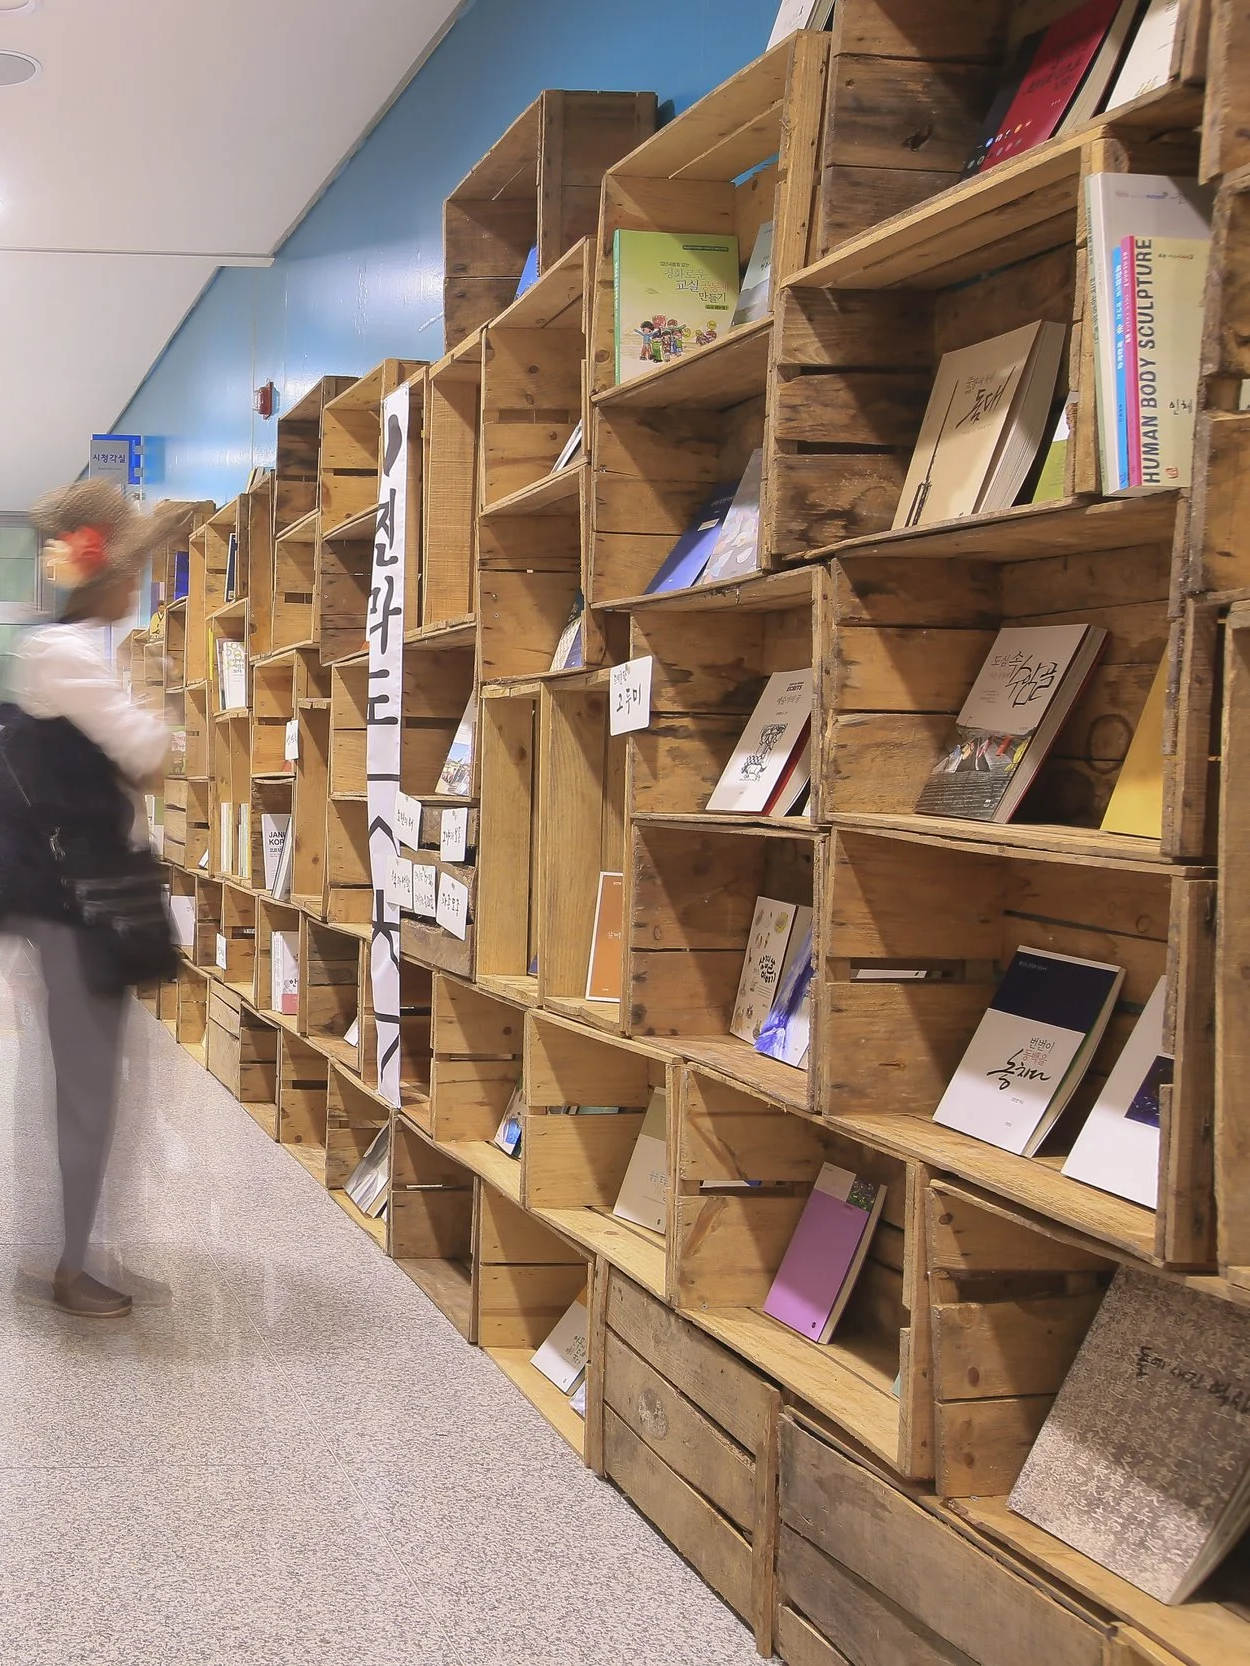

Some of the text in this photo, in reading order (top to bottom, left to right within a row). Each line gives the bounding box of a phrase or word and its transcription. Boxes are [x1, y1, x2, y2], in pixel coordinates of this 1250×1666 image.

[676, 280, 699, 293] 교실
[698, 292, 726, 303] 만들기
[1135, 238, 1161, 485] HUMAN BODY SCULPTURE
[92, 453, 126, 464] 시청각실
[616, 682, 642, 714] 고두미
[1029, 1037, 1056, 1053] 번번이
[1023, 1048, 1048, 1066] 동백을
[986, 1048, 1052, 1090] 놓치다
